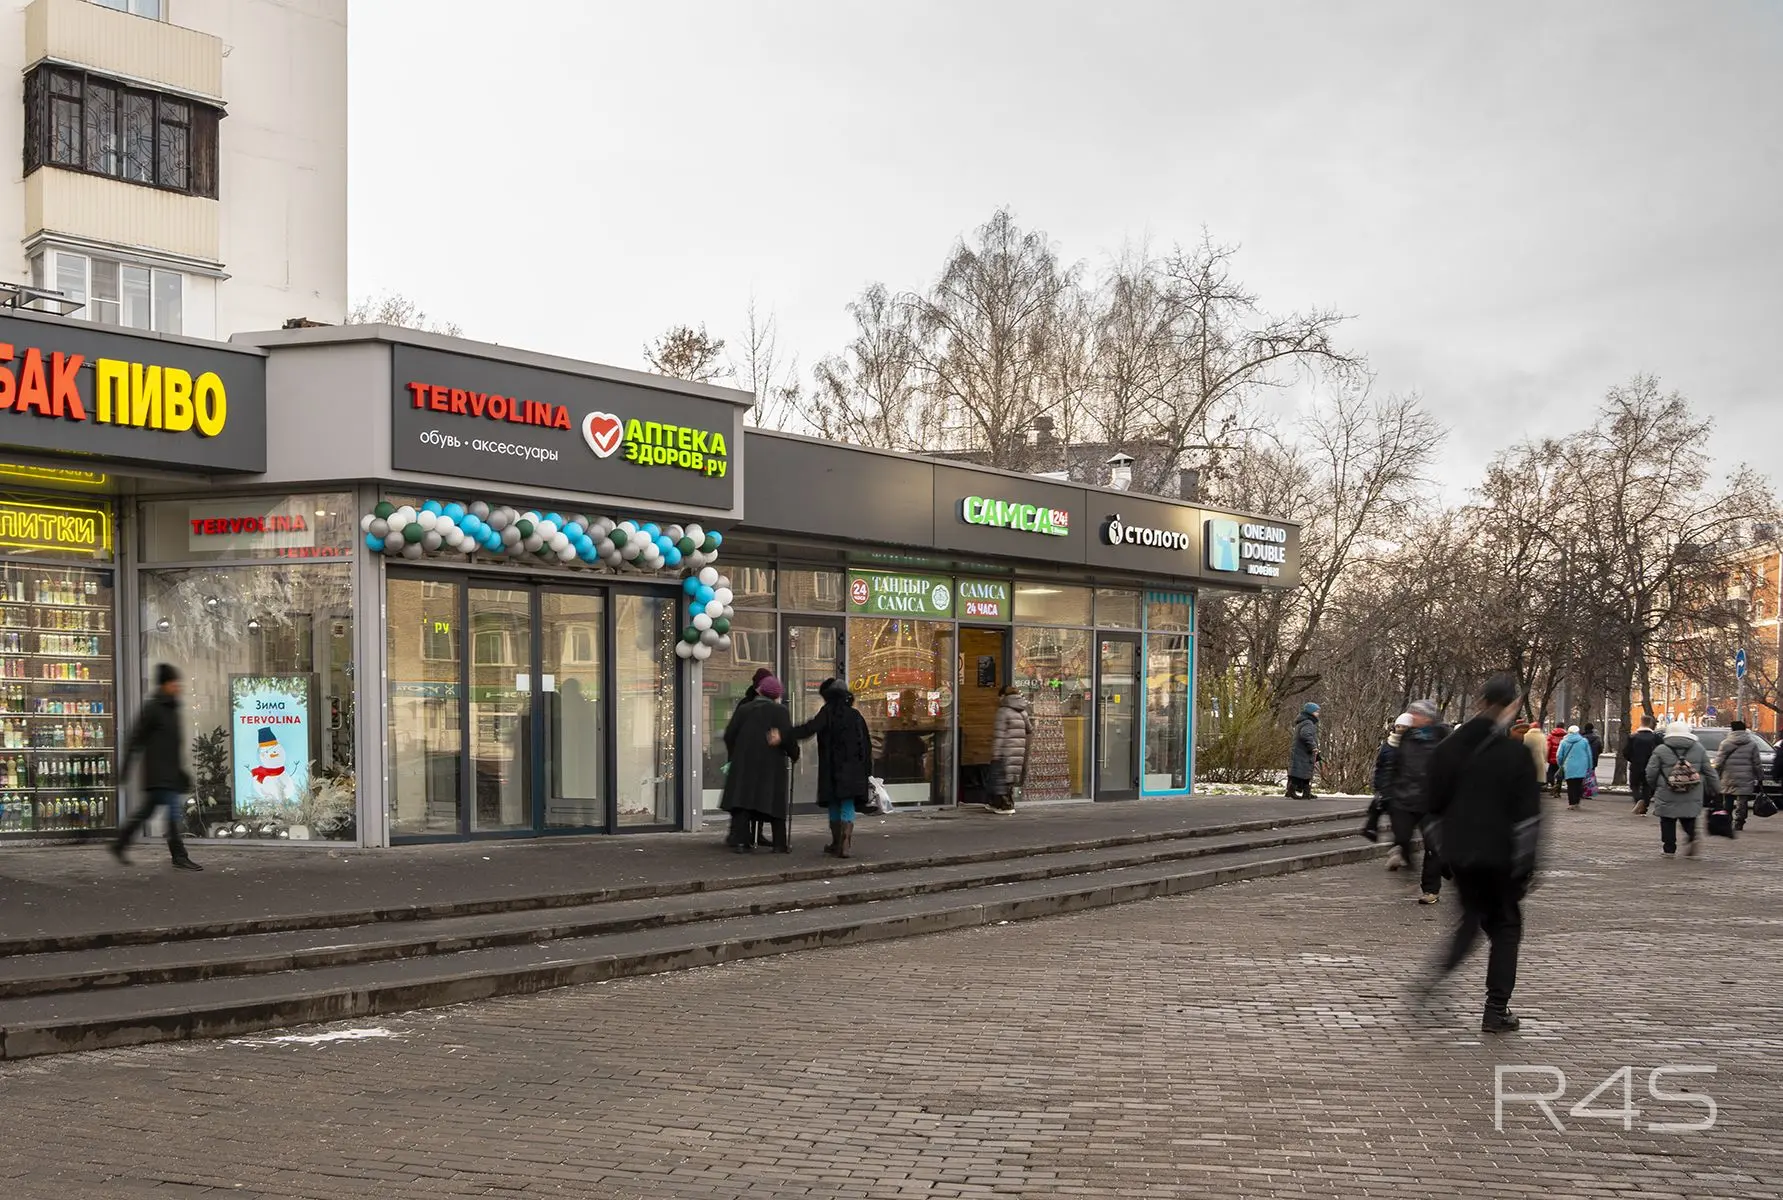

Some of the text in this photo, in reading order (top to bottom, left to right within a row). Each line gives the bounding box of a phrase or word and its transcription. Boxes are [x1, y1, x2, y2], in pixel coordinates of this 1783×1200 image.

[96, 358, 227, 436] ПИВО
[407, 382, 572, 430] TERVOLINA
[419, 430, 559, 461] обувь аксессуары
[624, 418, 727, 456] АПТЕКА
[191, 514, 308, 535] TERVOLINA
[963, 496, 1055, 534] САМСА
[1125, 528, 1190, 550] СТОЛОТО
[1241, 523, 1286, 543] ONE AND
[1241, 542, 1286, 563] DOUBLE
[853, 583, 867, 595] 24
[872, 576, 930, 595] ТАНДЫР
[960, 582, 1005, 599] САМСА
[878, 595, 925, 612] САМСА
[966, 602, 998, 616] 24 ЧАСА
[256, 700, 285, 710] Зима
[240, 715, 301, 724] TERVOLINA
